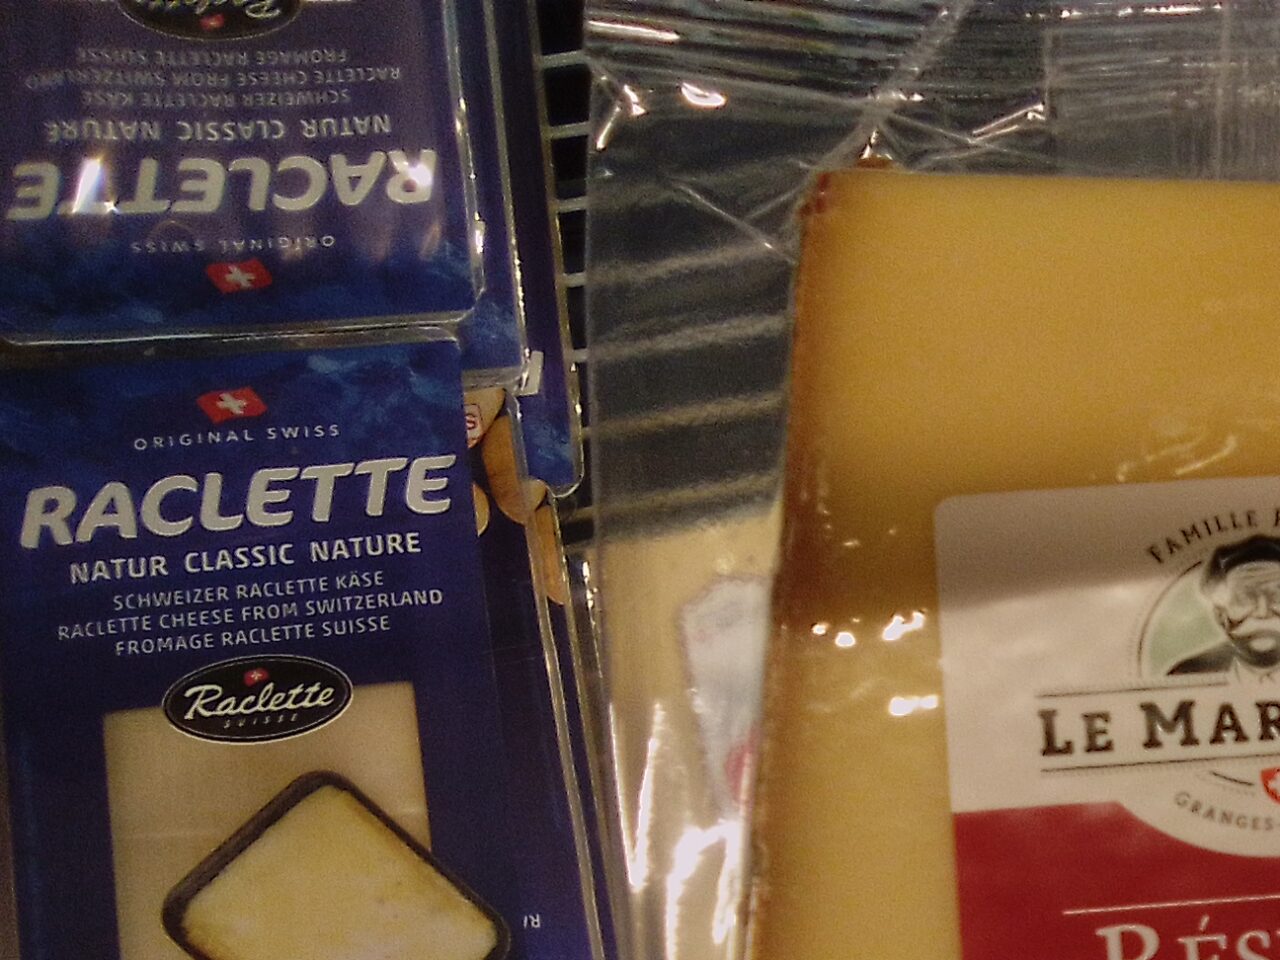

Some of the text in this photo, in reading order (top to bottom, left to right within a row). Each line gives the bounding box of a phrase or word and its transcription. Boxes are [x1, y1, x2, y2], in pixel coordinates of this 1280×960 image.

[45, 113, 391, 144] NATUR CLASSIC NATURE
[8, 149, 437, 220] RACLETTE
[133, 423, 342, 451] ORIGINAL SWISS
[19, 454, 458, 549] RACLETTE
[70, 532, 422, 584] NATUR CLASSIC NATURE
[1147, 508, 1258, 564] FAMILLE
[58, 589, 443, 640] RACLETTE CHEESE FROM SWITZERLAND
[113, 570, 385, 611] SCHWEIZER RACLETTE KÄSE
[115, 616, 390, 656] FROMAGE RACLETTE SUISSE
[184, 681, 335, 720] Raclette
[1039, 709, 1113, 757] LE
